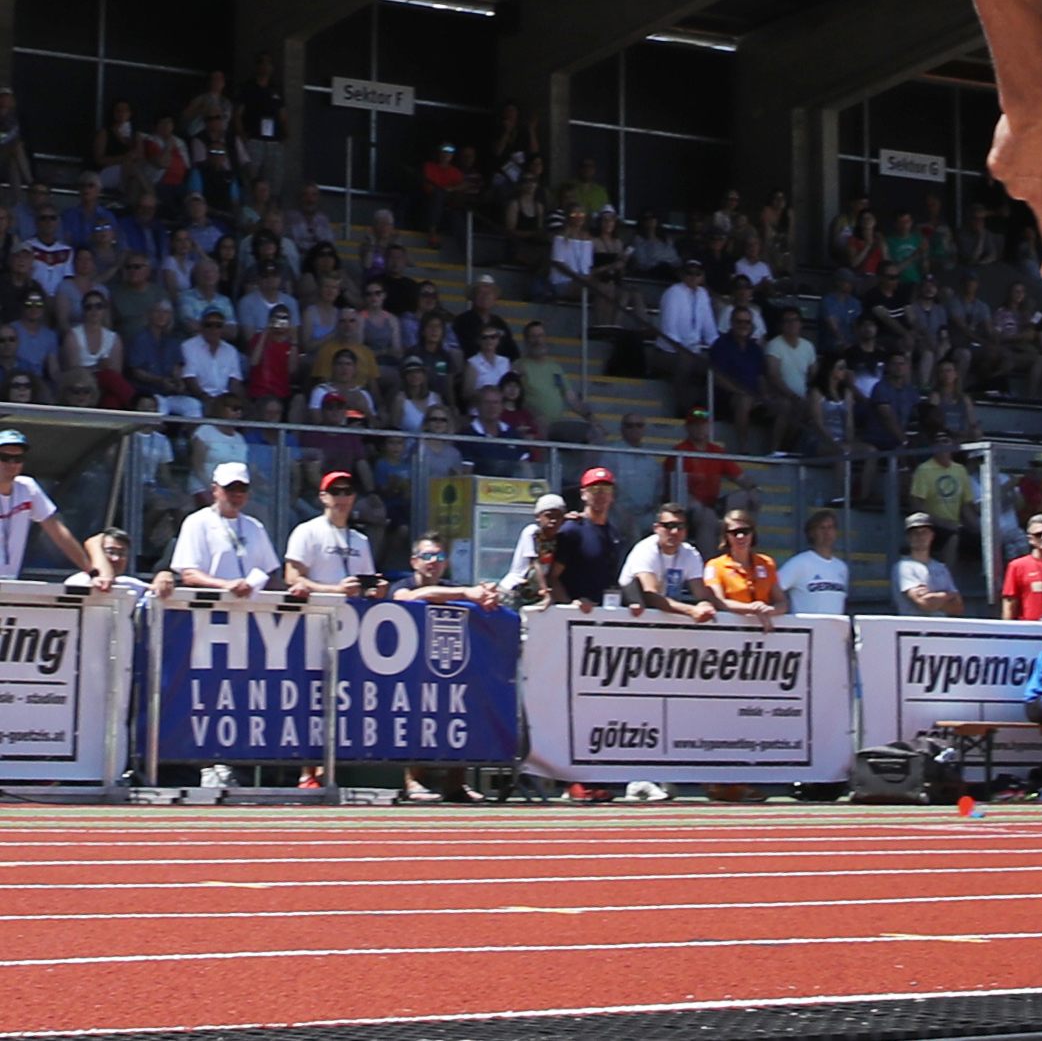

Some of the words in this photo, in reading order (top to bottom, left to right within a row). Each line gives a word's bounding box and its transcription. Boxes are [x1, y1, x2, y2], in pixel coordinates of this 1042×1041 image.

[344, 84, 392, 106] Sektor
[395, 91, 404, 107] F
[887, 156, 928, 173] Sektor
[0, 617, 70, 675] ing
[190, 602, 419, 675] HYPO
[580, 635, 803, 691] hypomeeting
[191, 679, 468, 713] LANDESBANK
[191, 715, 468, 749] VORARLBERG
[589, 721, 661, 754] götzis
